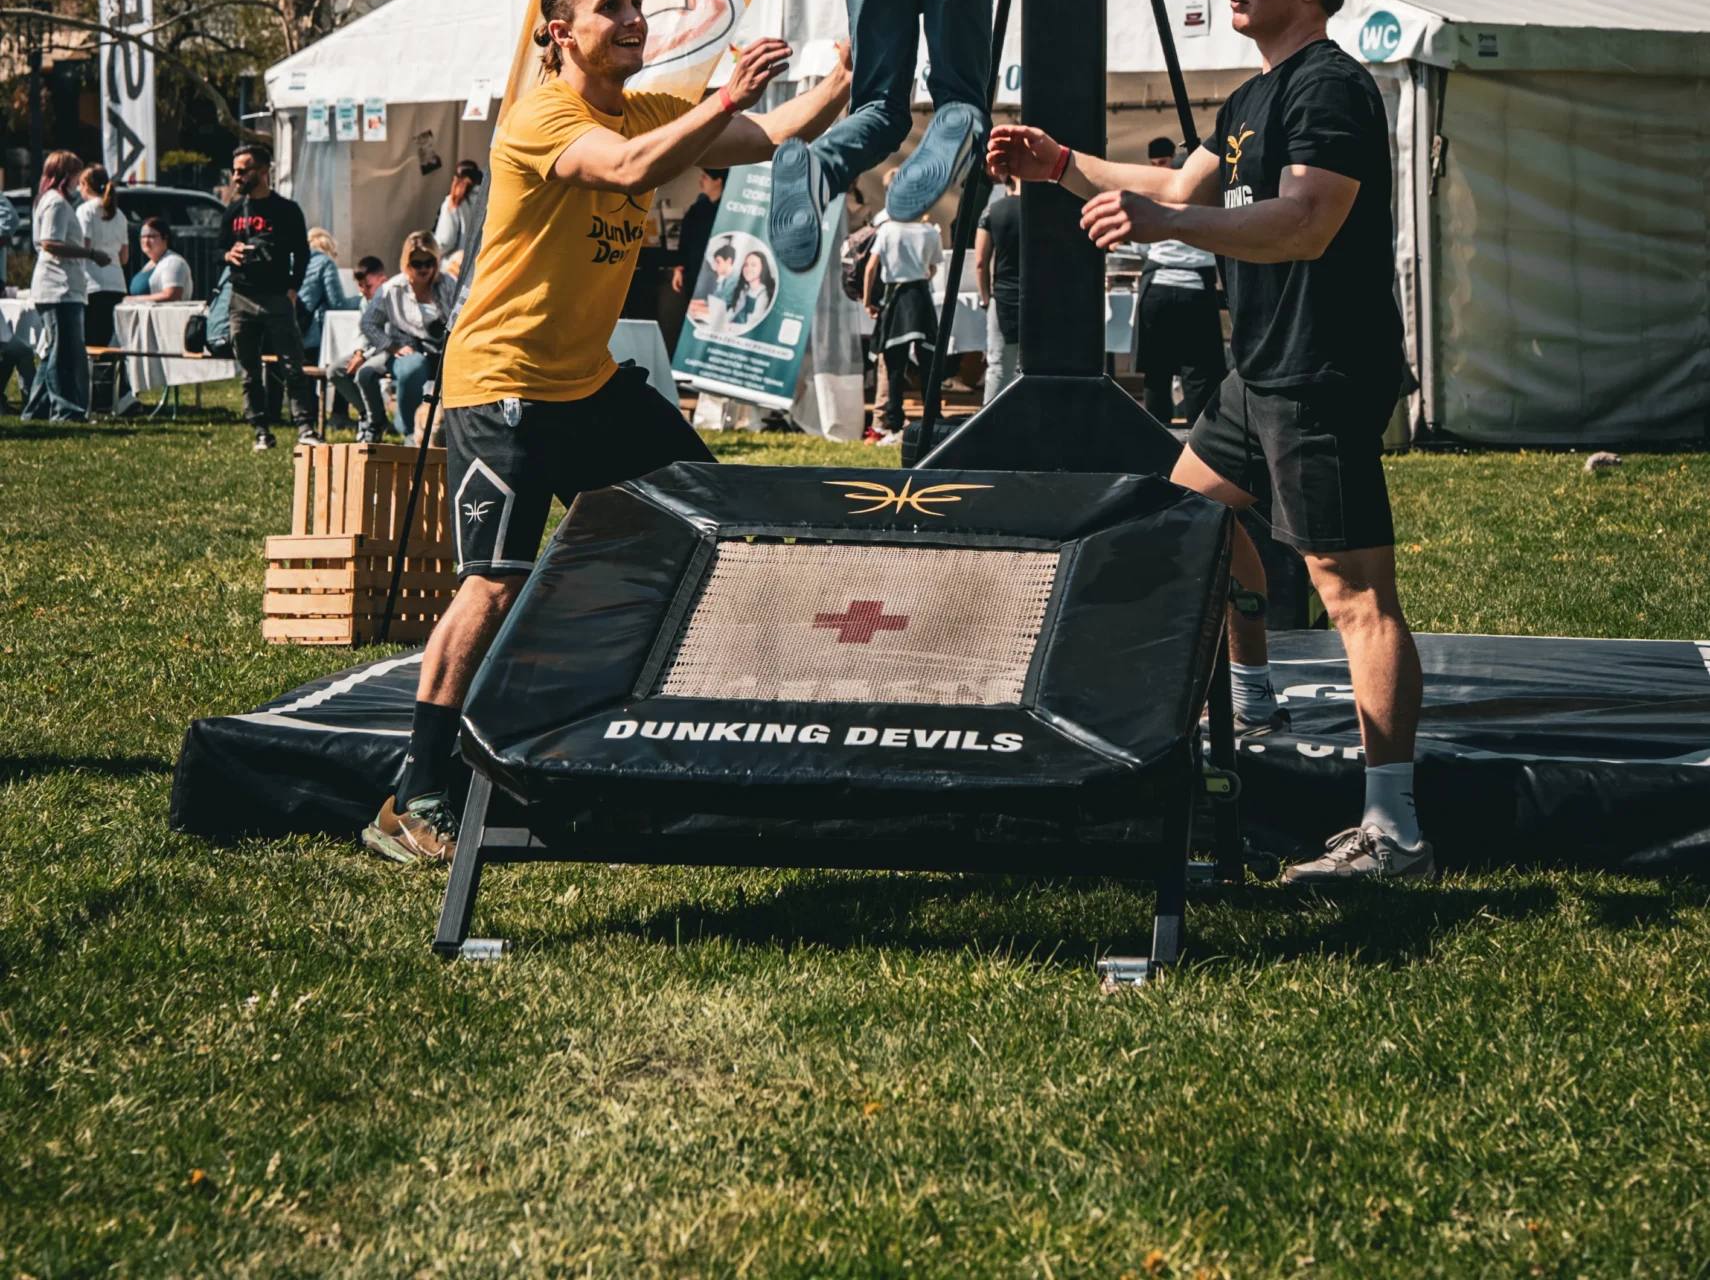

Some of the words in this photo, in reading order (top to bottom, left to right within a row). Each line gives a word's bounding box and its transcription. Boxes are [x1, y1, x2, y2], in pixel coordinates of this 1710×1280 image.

[1362, 24, 1399, 51] WC
[603, 720, 831, 744] DUNKING
[843, 726, 1024, 752] DEVILS
